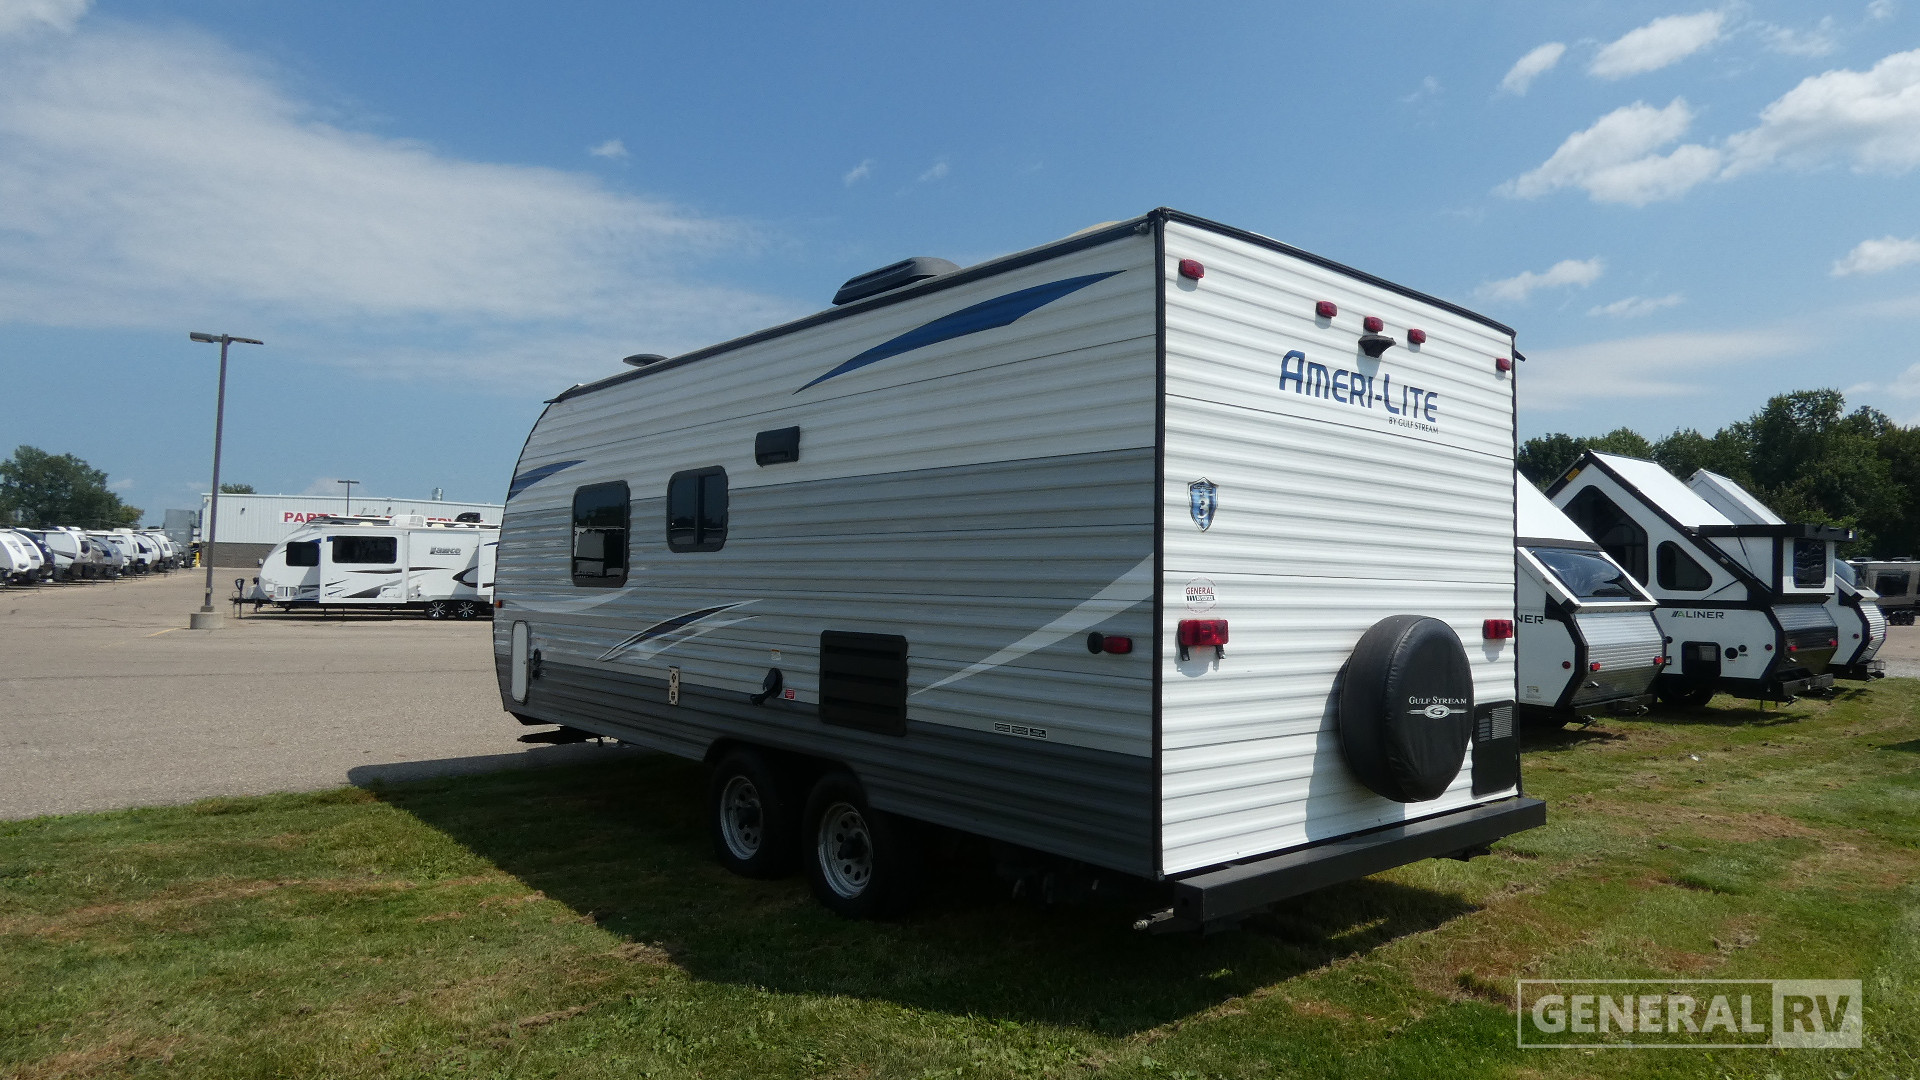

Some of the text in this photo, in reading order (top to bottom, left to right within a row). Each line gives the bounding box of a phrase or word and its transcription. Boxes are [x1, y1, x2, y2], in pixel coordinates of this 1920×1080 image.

[1279, 350, 1438, 422] AMERI-LITE
[1389, 417, 1439, 434] BY GULF STREAM
[284, 512, 338, 523] PAR
[1185, 587, 1214, 595] GENERAL
[1675, 611, 1724, 619] ALINER
[1408, 696, 1467, 704] GULF STREAM
